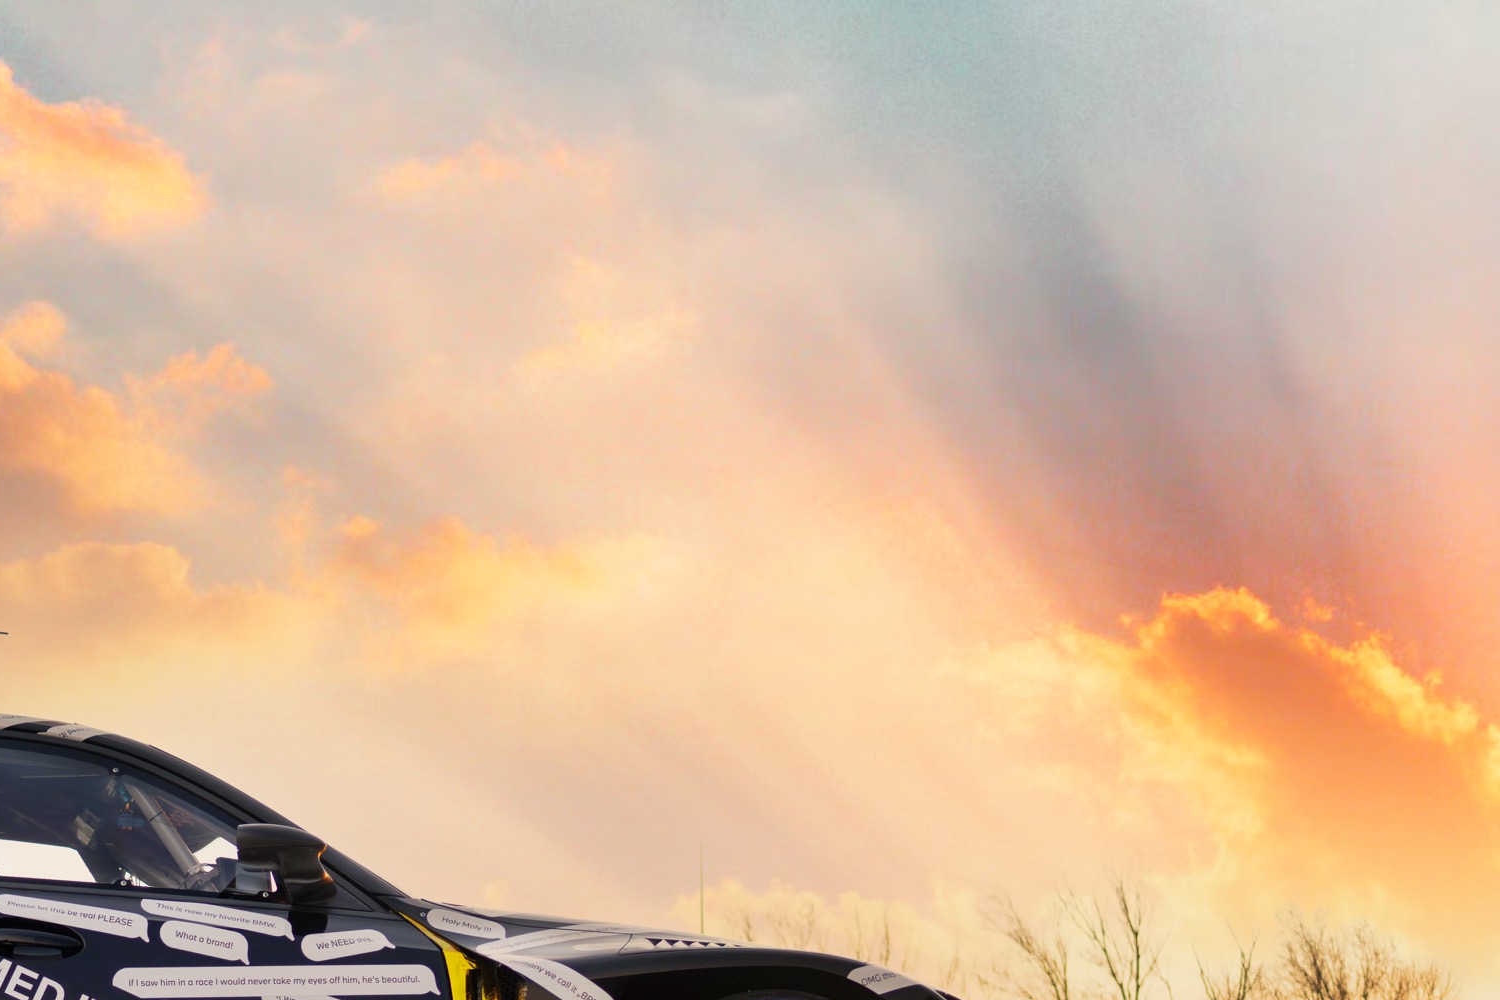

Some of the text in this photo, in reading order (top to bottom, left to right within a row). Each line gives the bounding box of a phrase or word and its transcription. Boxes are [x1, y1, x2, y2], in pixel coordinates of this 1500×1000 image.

[7, 901, 35, 909] Please
[50, 906, 66, 914] this
[67, 908, 78, 917] be
[79, 911, 96, 919] real
[97, 913, 133, 927] PLEASE
[157, 903, 173, 911] This
[184, 908, 202, 916] now
[204, 911, 217, 919] my
[218, 913, 250, 924] favorite
[252, 919, 277, 929] BMW.
[442, 916, 461, 926] Holy
[462, 922, 482, 931] Moly
[175, 930, 197, 942] What
[206, 937, 234, 949] brand!
[315, 942, 329, 950] We
[331, 938, 355, 947] NEED
[128, 978, 135, 987] If
[135, 979, 139, 987] I
[160, 978, 176, 987] him
[178, 978, 186, 986] in
[215, 978, 218, 986] I
[219, 977, 246, 986] would
[272, 977, 291, 985] take
[293, 977, 306, 987] my
[307, 977, 327, 987] eyes
[329, 976, 341, 984] off
[342, 976, 361, 985] him,
[362, 975, 380, 984] he's
[381, 975, 421, 984] beautiful.
[545, 969, 557, 980] we
[557, 977, 572, 989] call
[570, 984, 578, 993] it
[861, 972, 896, 987] OMG this
